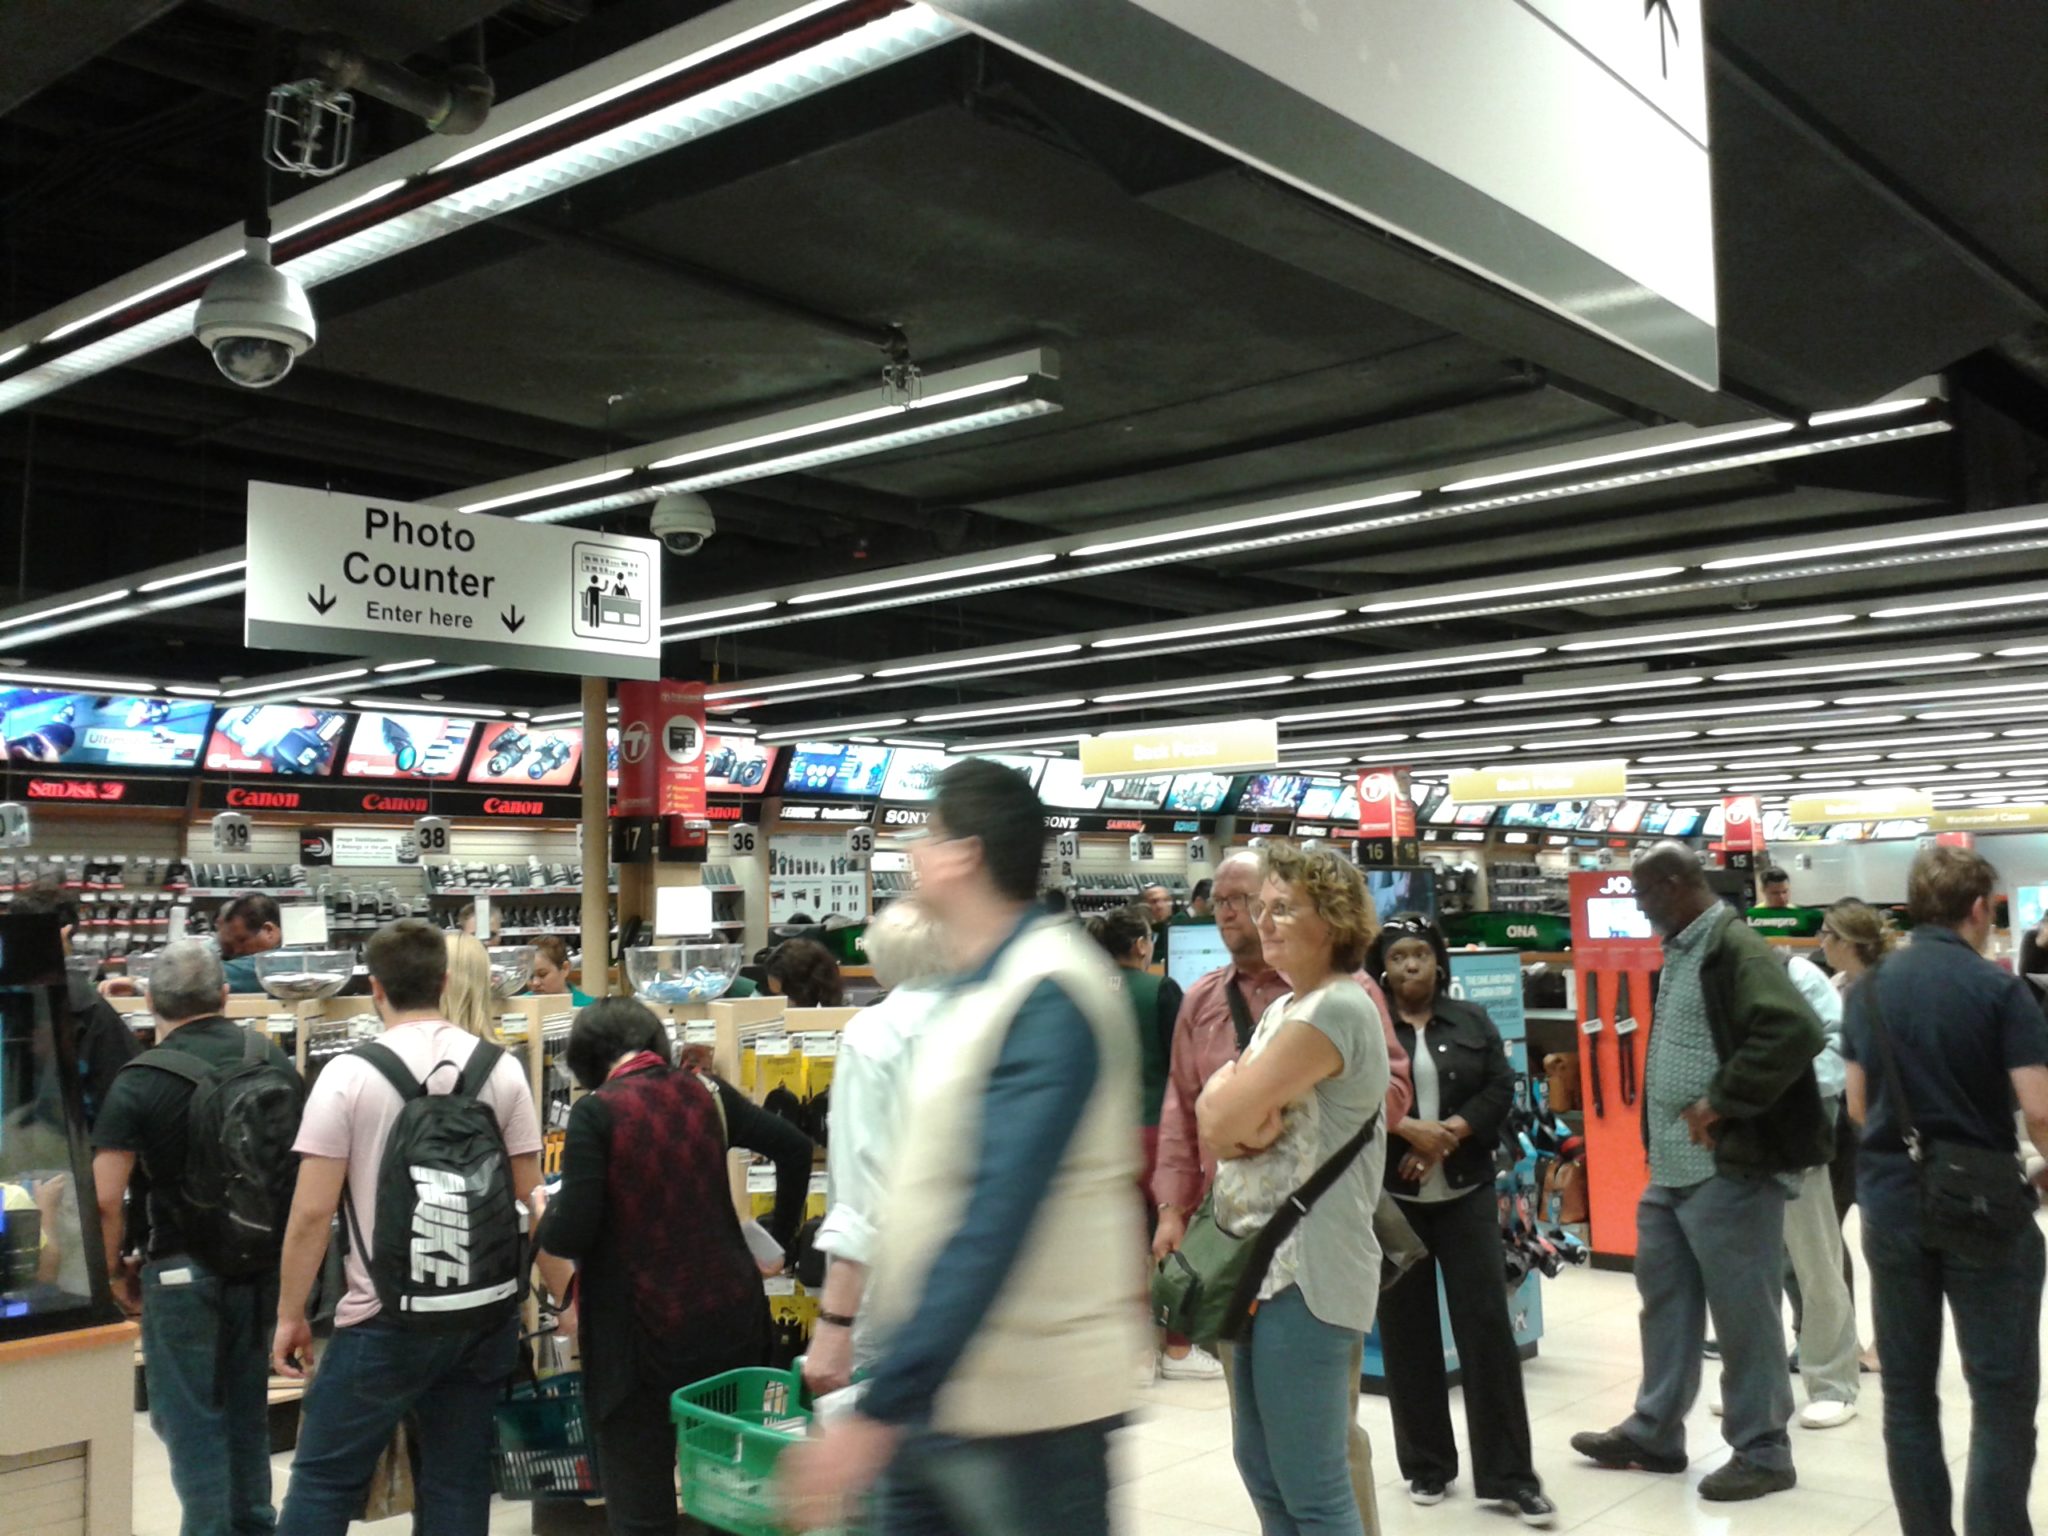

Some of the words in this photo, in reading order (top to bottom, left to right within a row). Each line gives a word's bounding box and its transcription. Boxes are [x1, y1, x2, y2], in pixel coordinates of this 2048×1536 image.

[365, 507, 475, 552] Photo
[343, 551, 496, 598] Counter
[366, 601, 422, 625] Enter
[429, 607, 473, 628] here
[28, 780, 98, 799] SanDisk
[226, 788, 300, 808] Canon
[361, 794, 429, 812] Canon
[483, 797, 544, 815] Canon
[705, 806, 741, 820] anon
[885, 809, 931, 824] SONY
[1043, 816, 1080, 829] SONY
[226, 823, 248, 847] 39
[419, 827, 446, 849] 38
[625, 826, 642, 851] 17
[733, 832, 755, 851] 36
[851, 834, 872, 851] 35
[1059, 841, 1073, 856] 33
[1139, 841, 1152, 857] 32
[1190, 844, 1204, 859] 31
[1366, 842, 1384, 860] 16
[1731, 854, 1747, 868] 15
[1599, 876, 1637, 894] JO
[1747, 917, 1798, 928] Lowepro
[409, 1165, 470, 1288] NIKE
